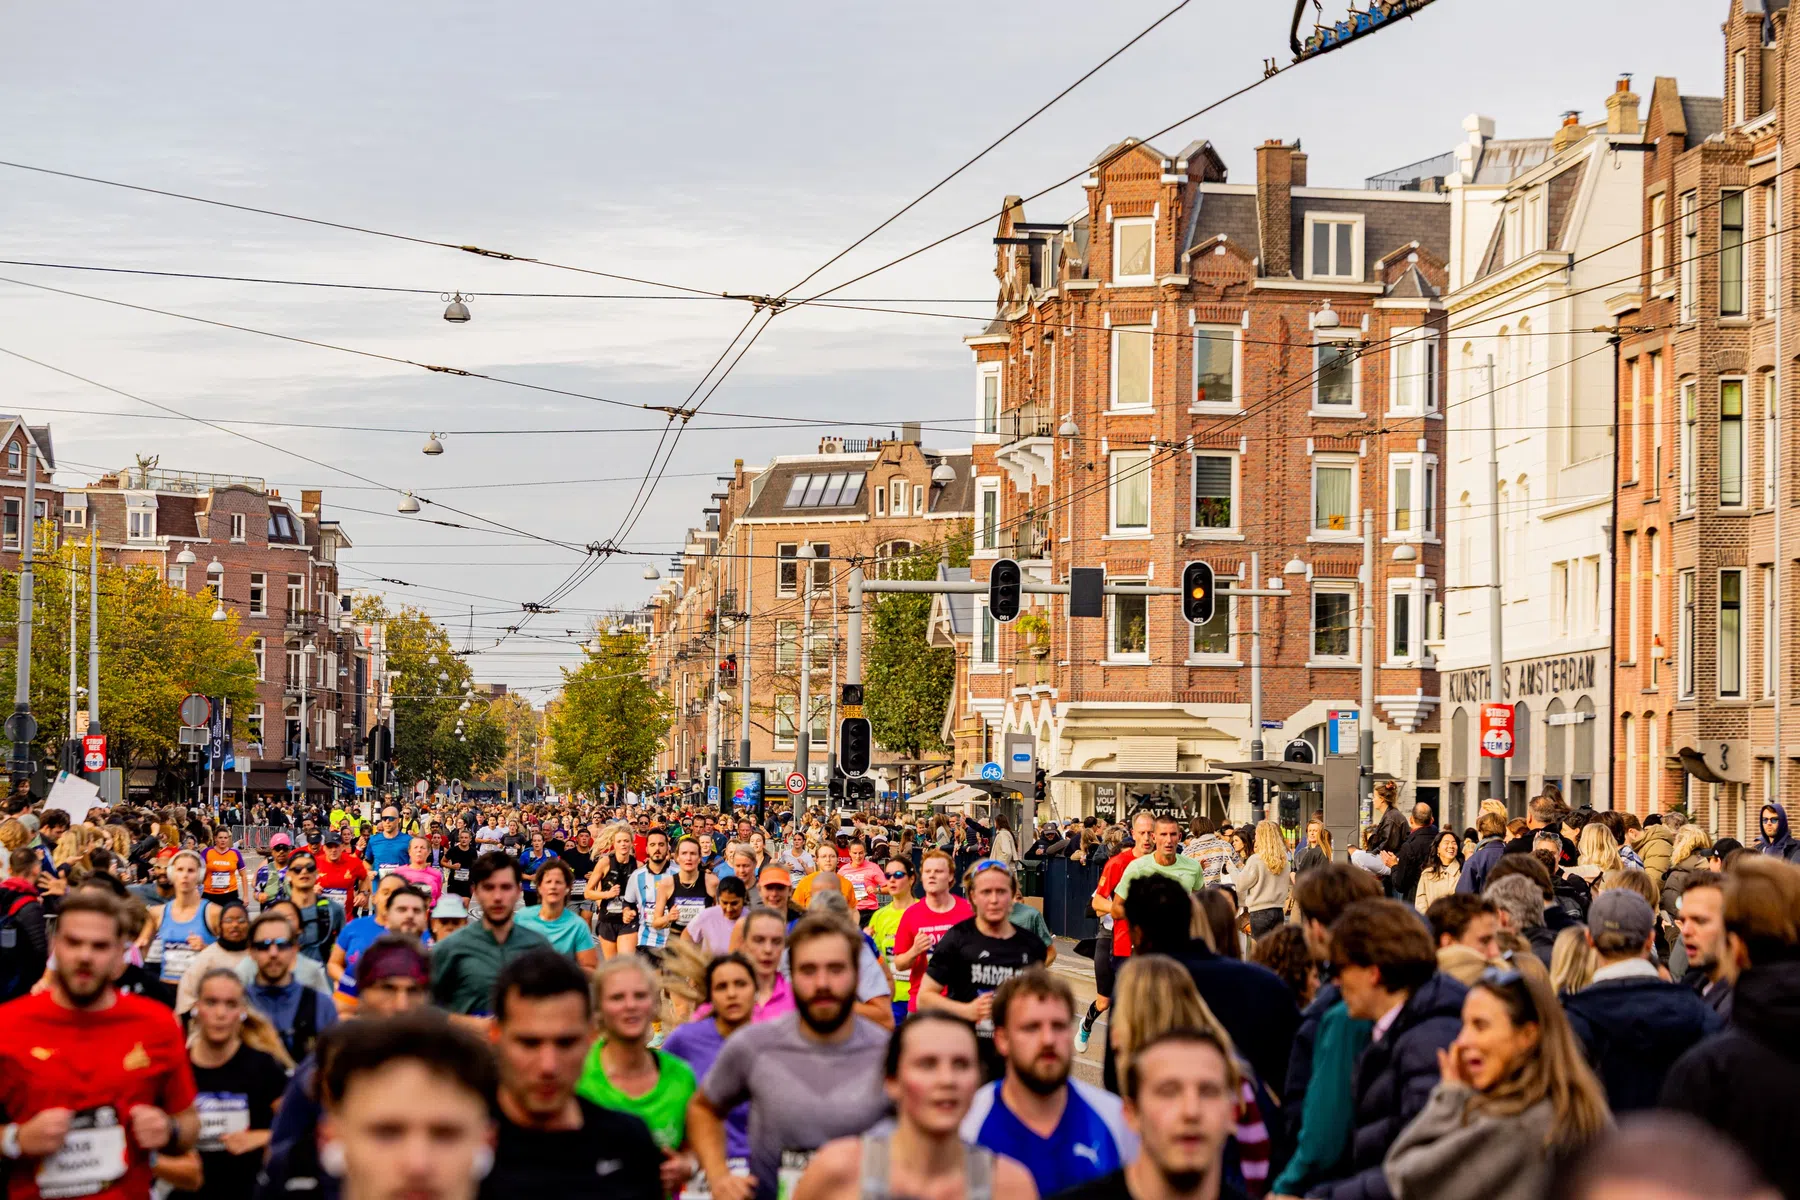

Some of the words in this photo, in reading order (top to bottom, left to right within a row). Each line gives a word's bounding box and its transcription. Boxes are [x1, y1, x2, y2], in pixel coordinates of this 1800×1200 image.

[1449, 666, 1511, 702] KUNSTHS
[1518, 654, 1595, 696] AMSTERDAM
[790, 779, 802, 788] 30
[1098, 786, 1114, 795] Run
[1096, 796, 1115, 806] your
[1096, 806, 1115, 814] way.
